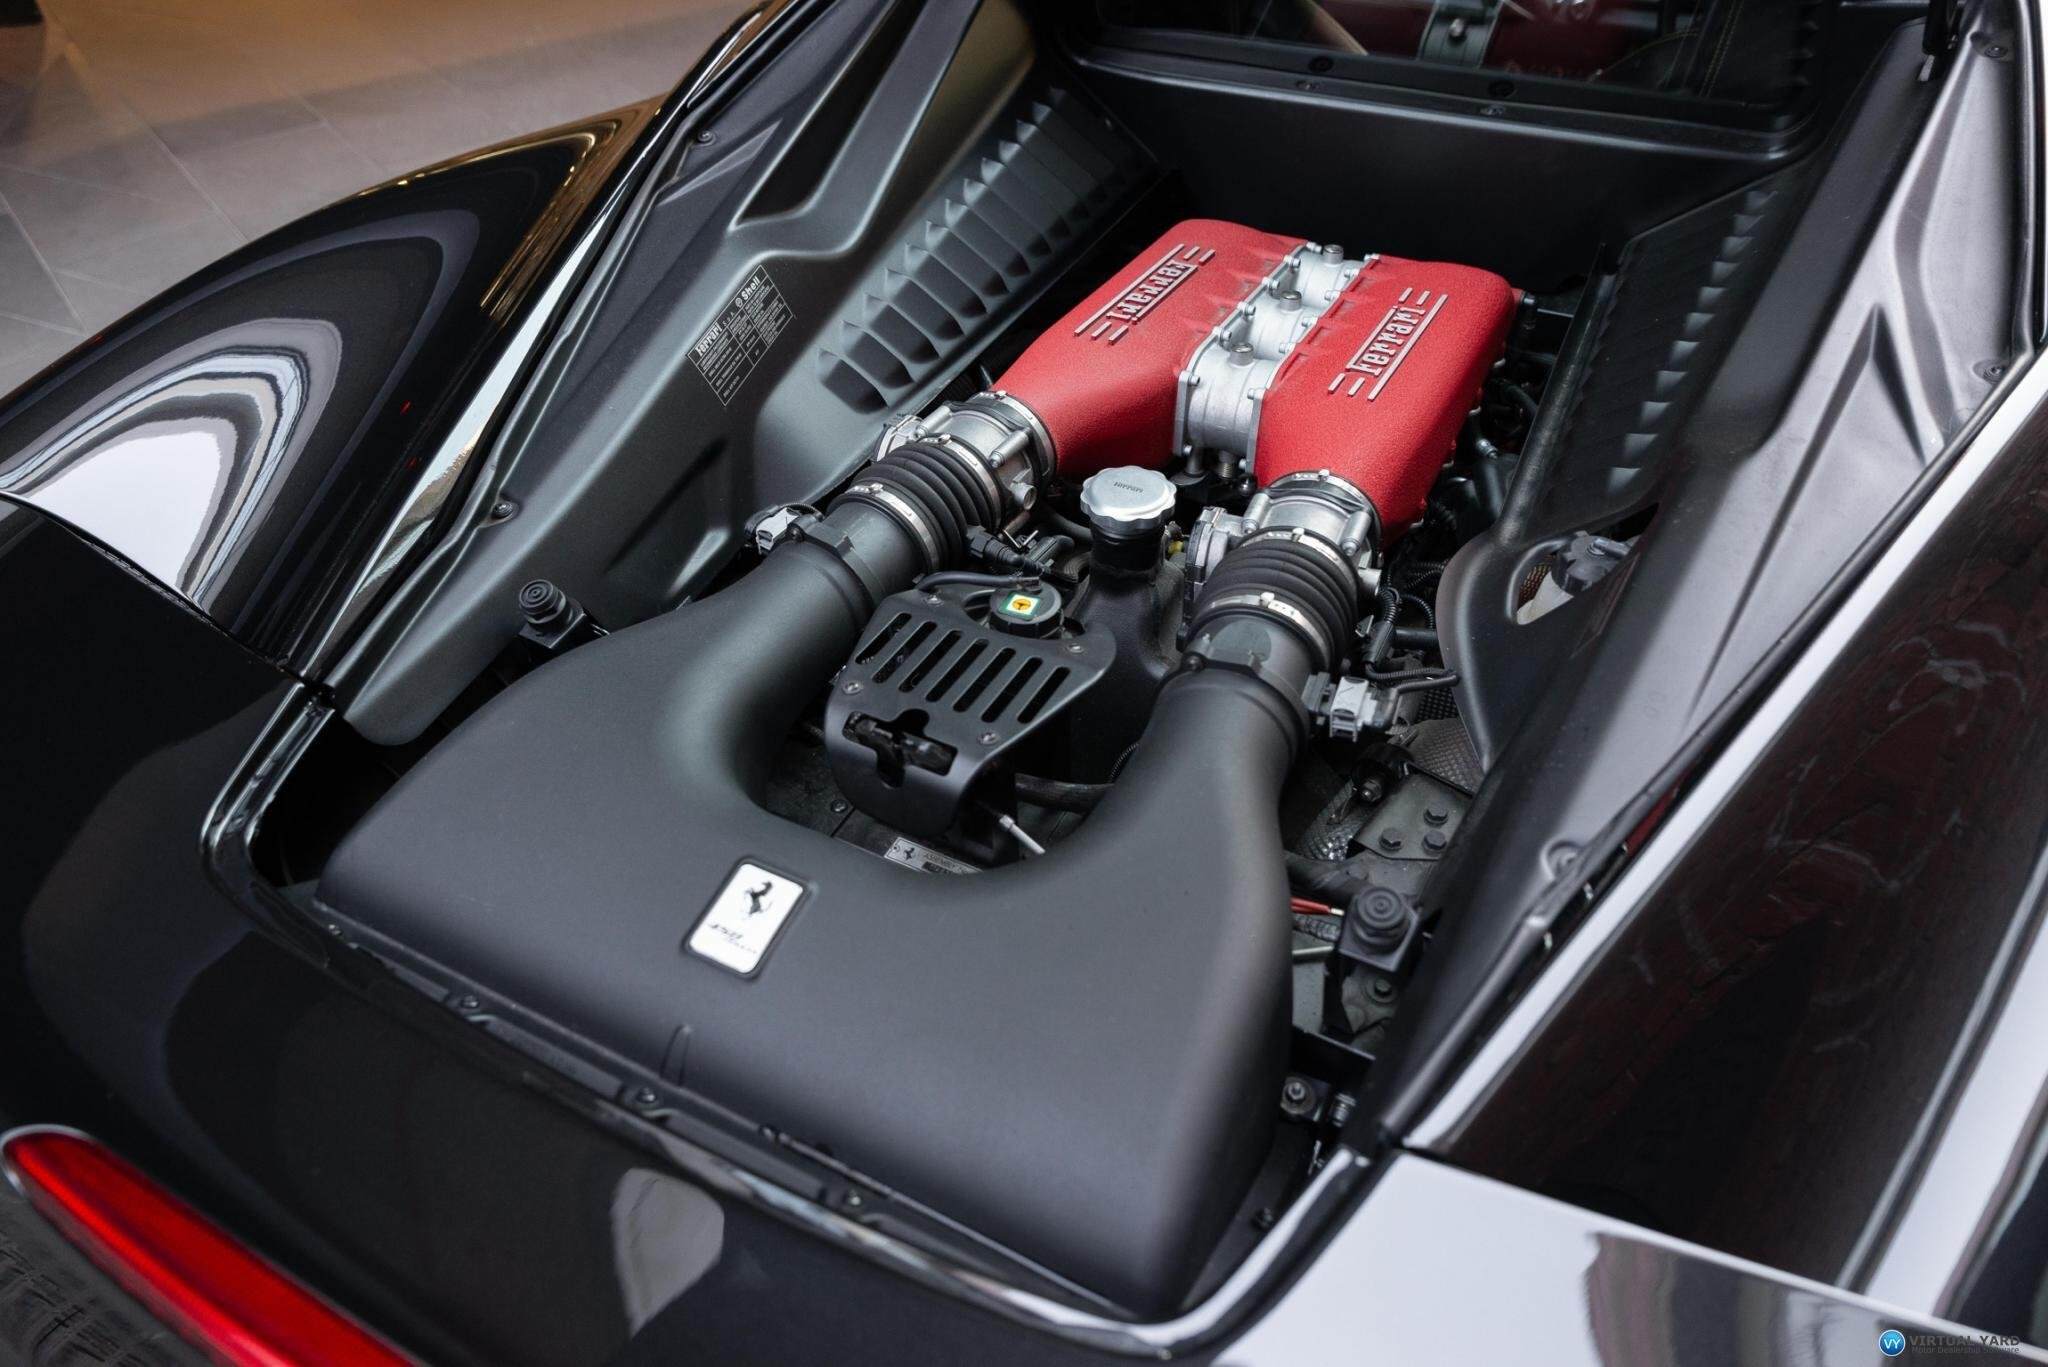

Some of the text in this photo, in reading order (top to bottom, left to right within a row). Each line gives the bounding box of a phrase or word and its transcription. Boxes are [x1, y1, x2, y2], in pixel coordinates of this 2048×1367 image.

[695, 321, 723, 357] Ferrari
[741, 276, 761, 301] Shell
[1106, 259, 1199, 322] Ferrari
[1345, 305, 1426, 377] Ferrari
